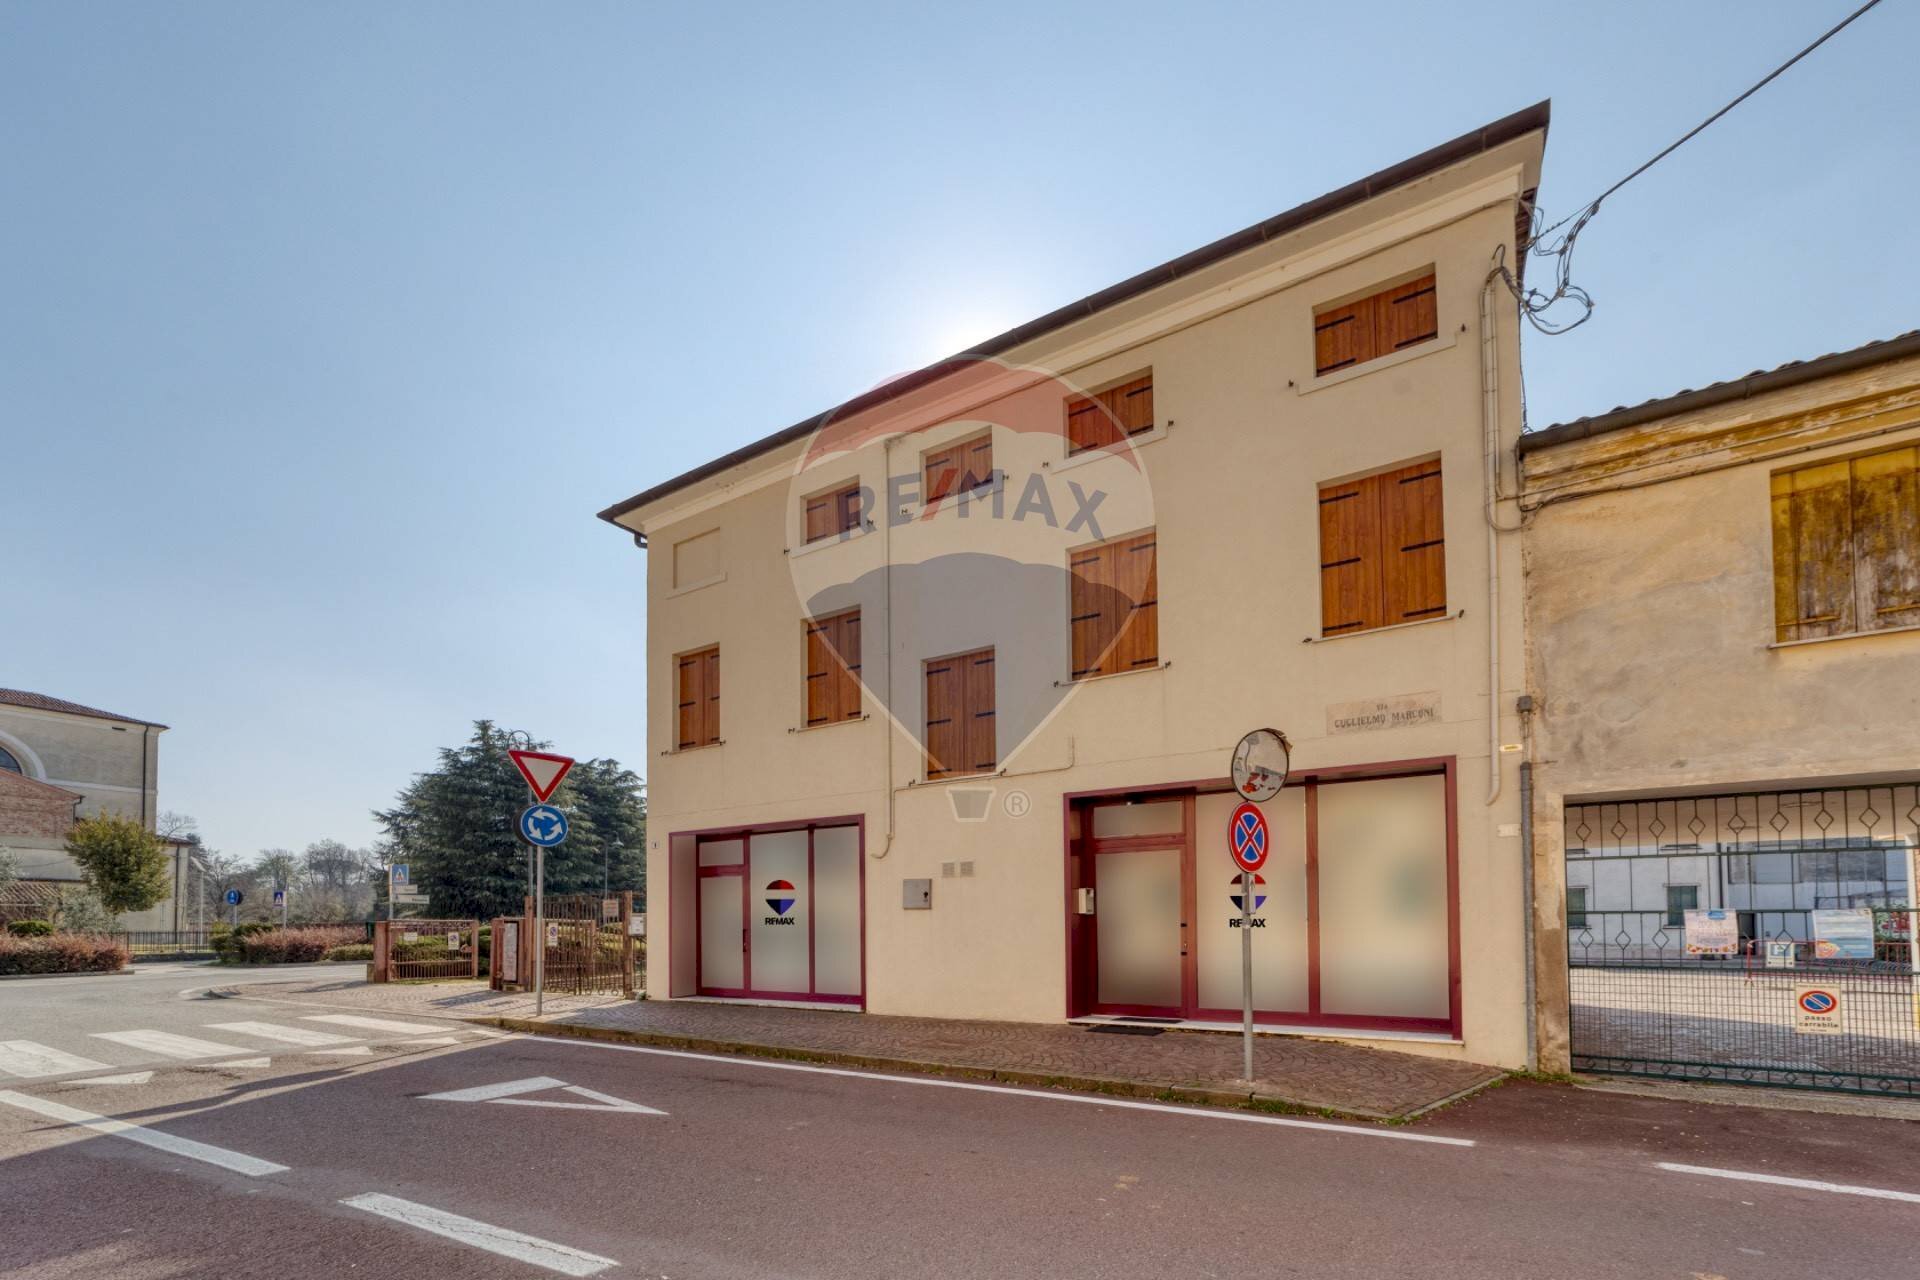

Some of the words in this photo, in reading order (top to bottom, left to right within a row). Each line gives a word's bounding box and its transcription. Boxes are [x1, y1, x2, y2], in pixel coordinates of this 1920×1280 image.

[1334, 714, 1386, 728] GUGLIELMO
[1391, 708, 1434, 721] MARCONI
[1229, 918, 1266, 928] REAX
